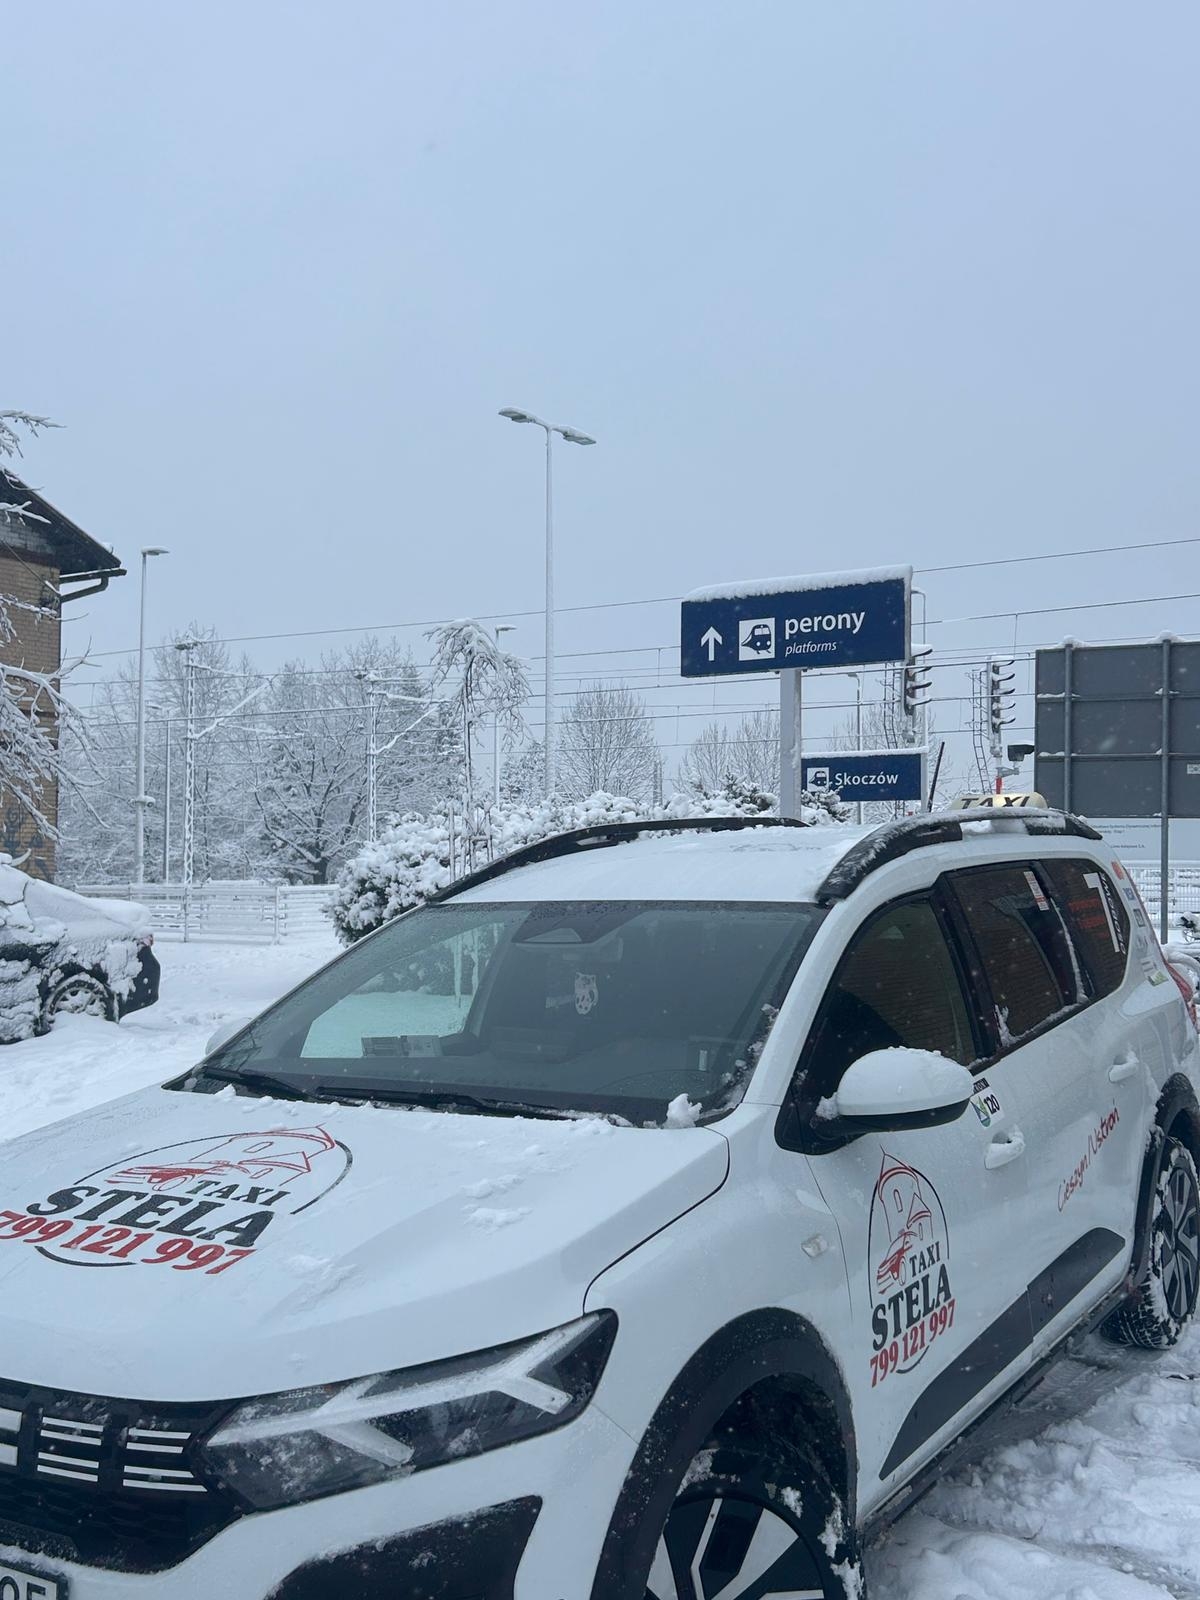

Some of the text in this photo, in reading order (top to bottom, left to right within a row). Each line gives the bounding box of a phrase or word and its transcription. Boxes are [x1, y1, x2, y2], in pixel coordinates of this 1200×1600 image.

[785, 612, 865, 639] perony
[785, 640, 837, 657] platforms
[835, 772, 898, 786] Skoczów
[961, 796, 1030, 809] TAXI
[984, 1094, 1000, 1115] 120
[186, 1180, 290, 1206] TAXI
[26, 1185, 275, 1248] STELA
[0, 1210, 257, 1275] 799 121 997
[909, 1242, 941, 1277] TAXI
[872, 1264, 952, 1351] STELA
[870, 1299, 955, 1388] 799 121 997
